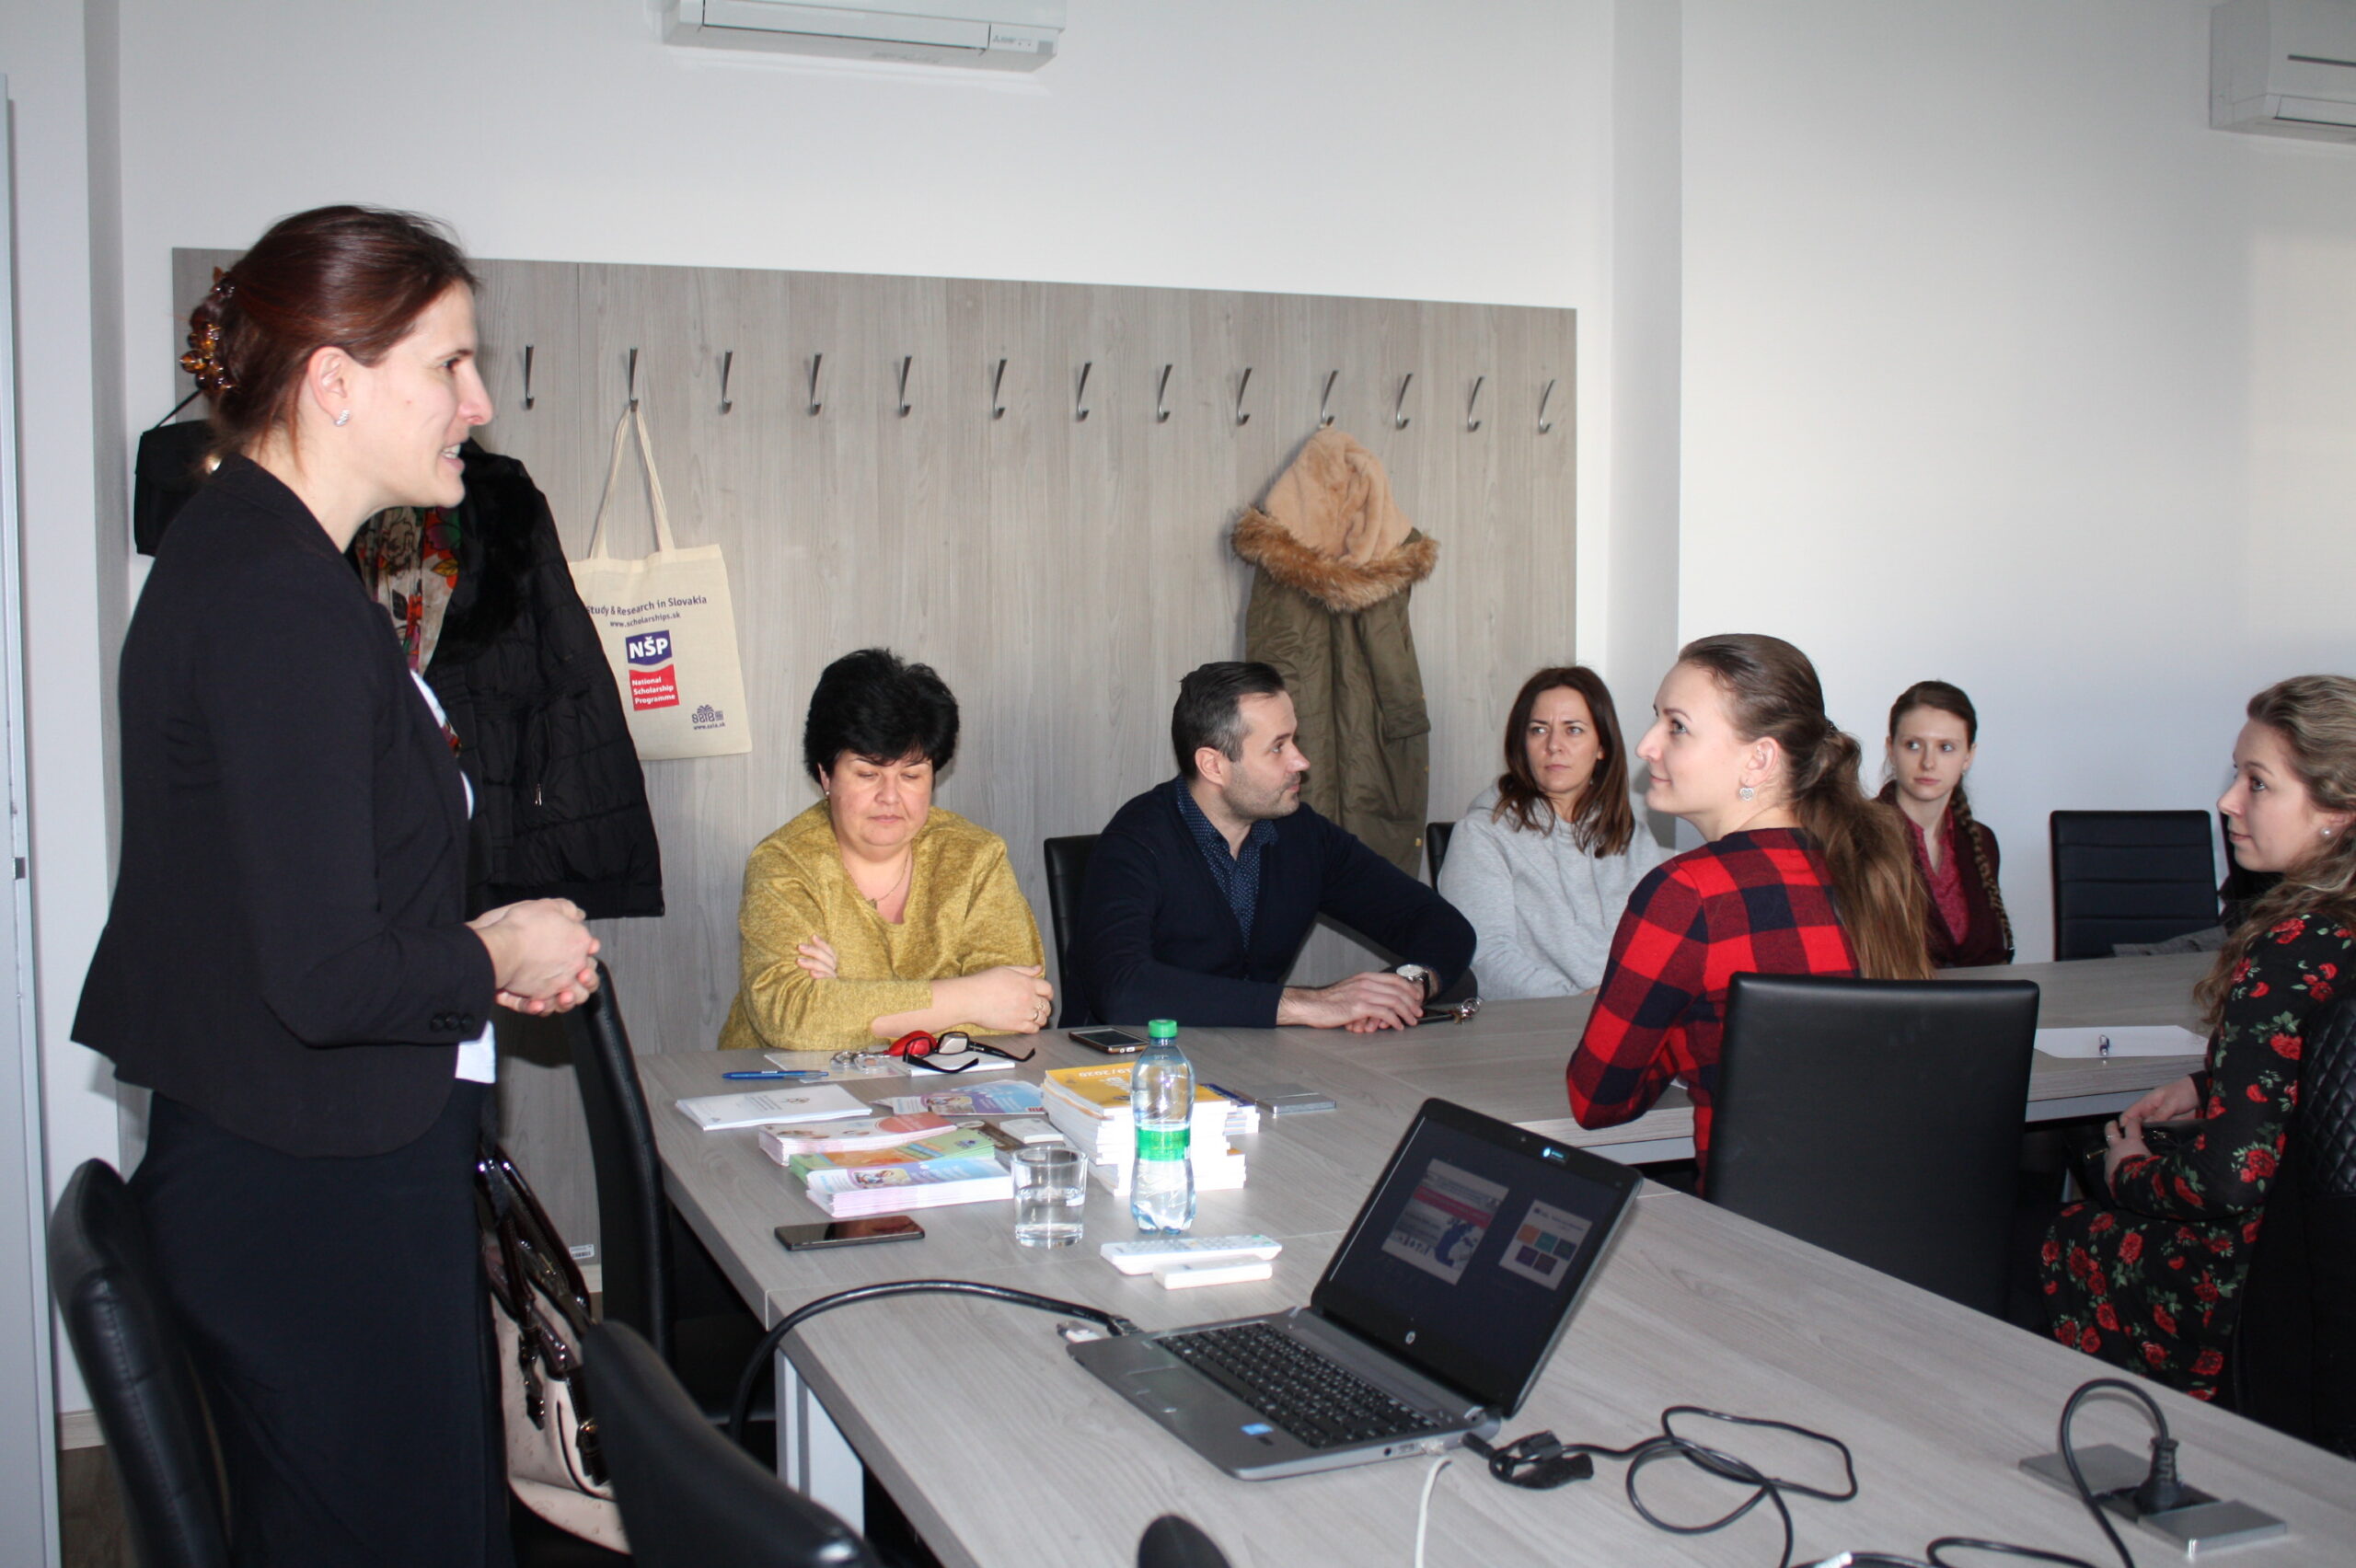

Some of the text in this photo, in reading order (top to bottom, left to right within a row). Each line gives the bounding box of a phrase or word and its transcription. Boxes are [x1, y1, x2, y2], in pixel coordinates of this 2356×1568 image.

[610, 605, 616, 616] &
[617, 601, 655, 616] Research
[656, 599, 666, 608] in
[668, 594, 707, 607] Slovakia
[610, 611, 681, 628] www.scholarships.sk
[629, 636, 668, 659] NŠP
[631, 676, 662, 686] National
[633, 685, 674, 696] Scholarship
[634, 694, 676, 705] Programme
